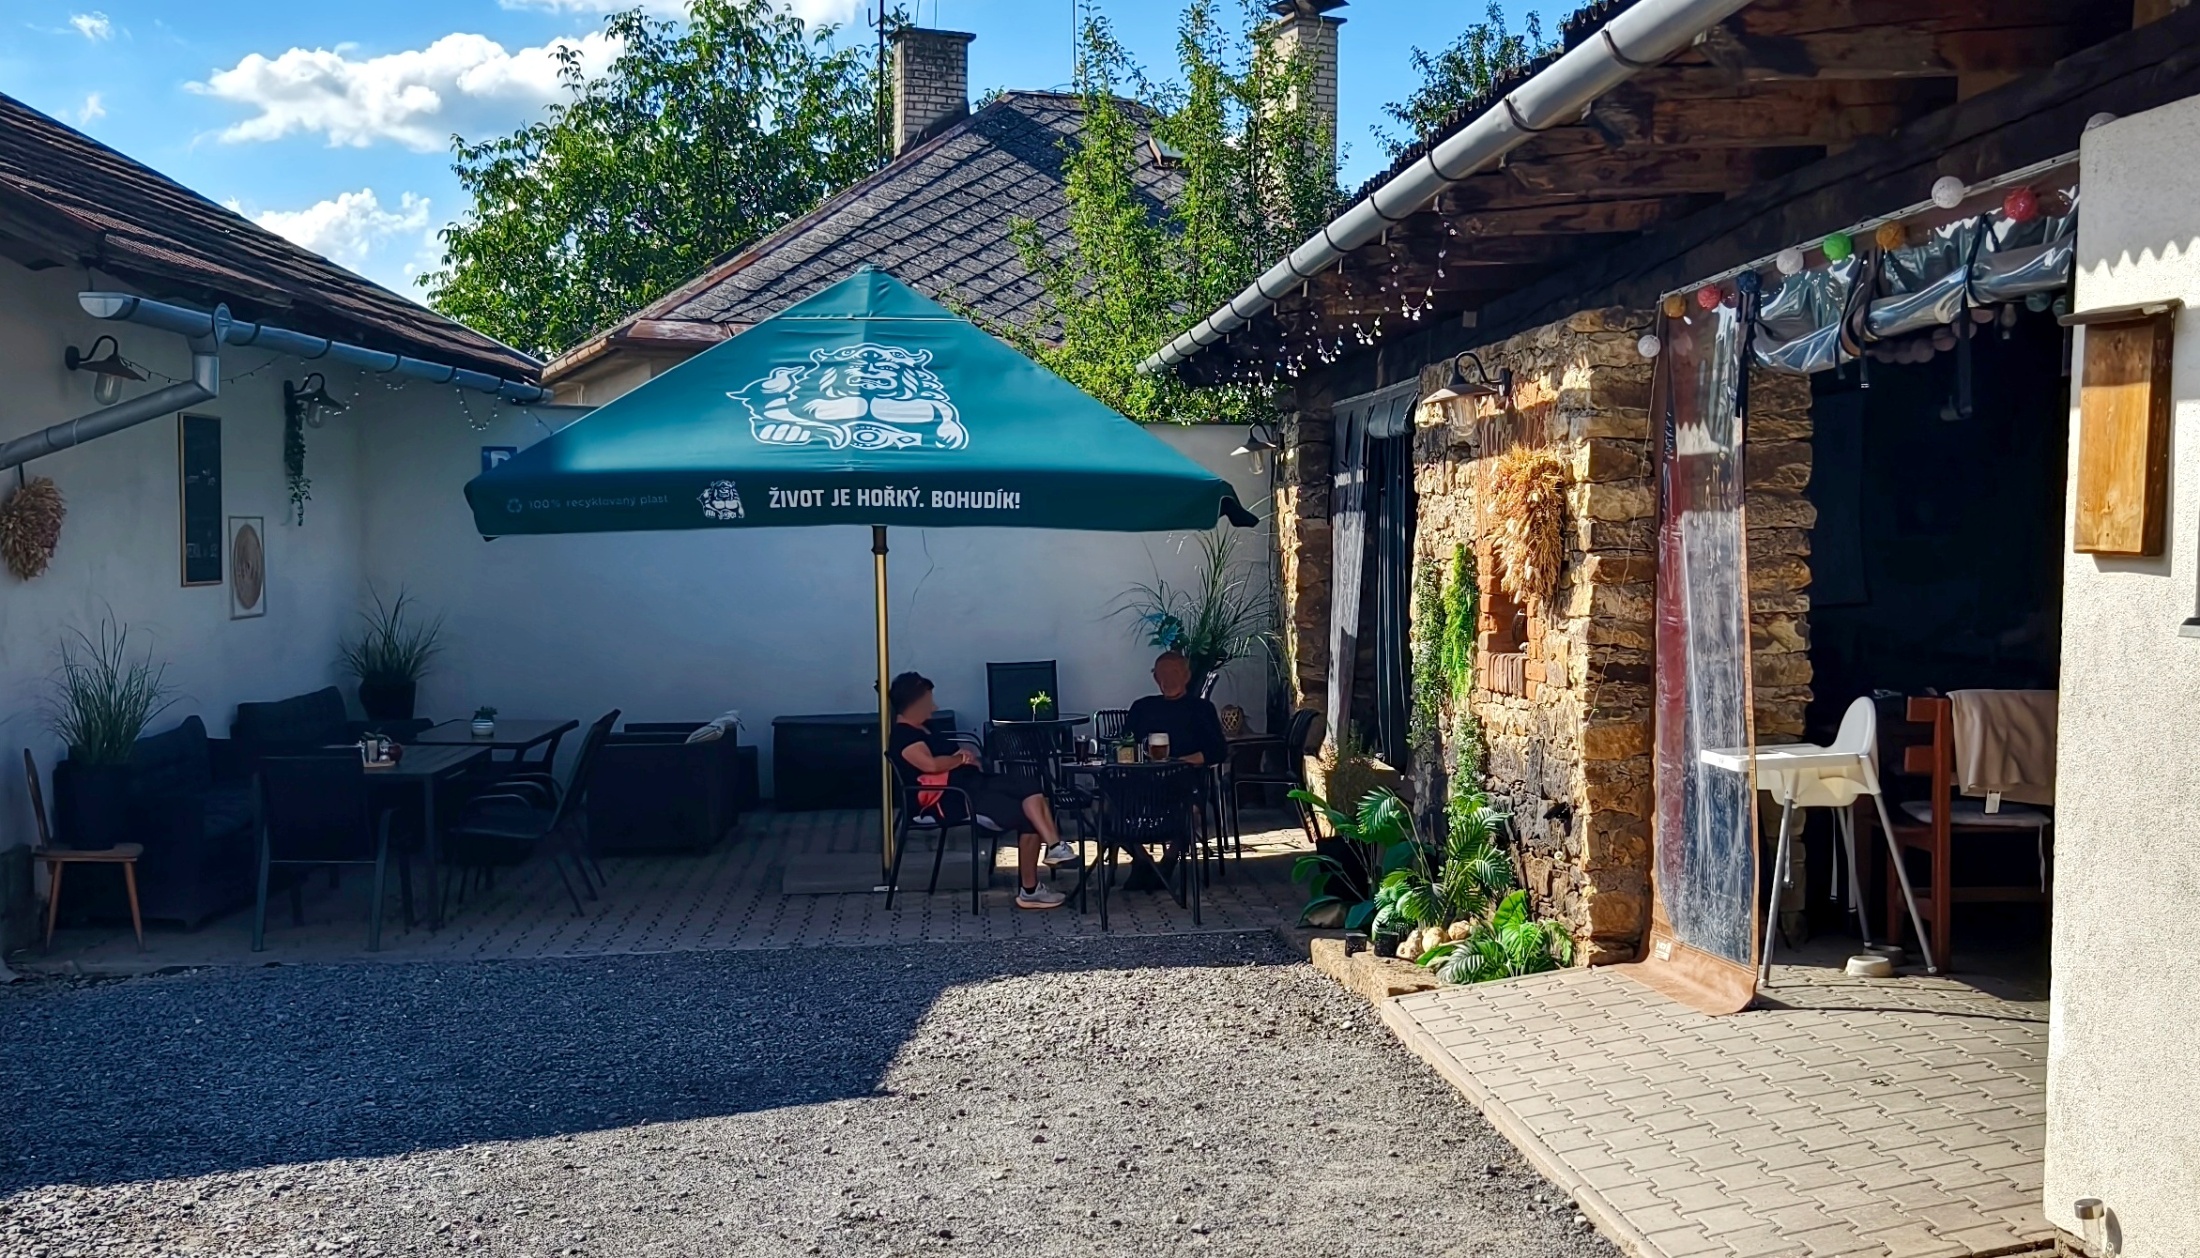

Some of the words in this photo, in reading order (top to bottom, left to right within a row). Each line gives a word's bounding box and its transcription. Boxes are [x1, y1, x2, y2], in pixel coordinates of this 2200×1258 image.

[768, 487, 824, 508] ŽIVOT
[831, 488, 851, 506] JE
[857, 485, 924, 507] HOŘKÝ.
[931, 488, 1020, 509] BOHUDÍK!
